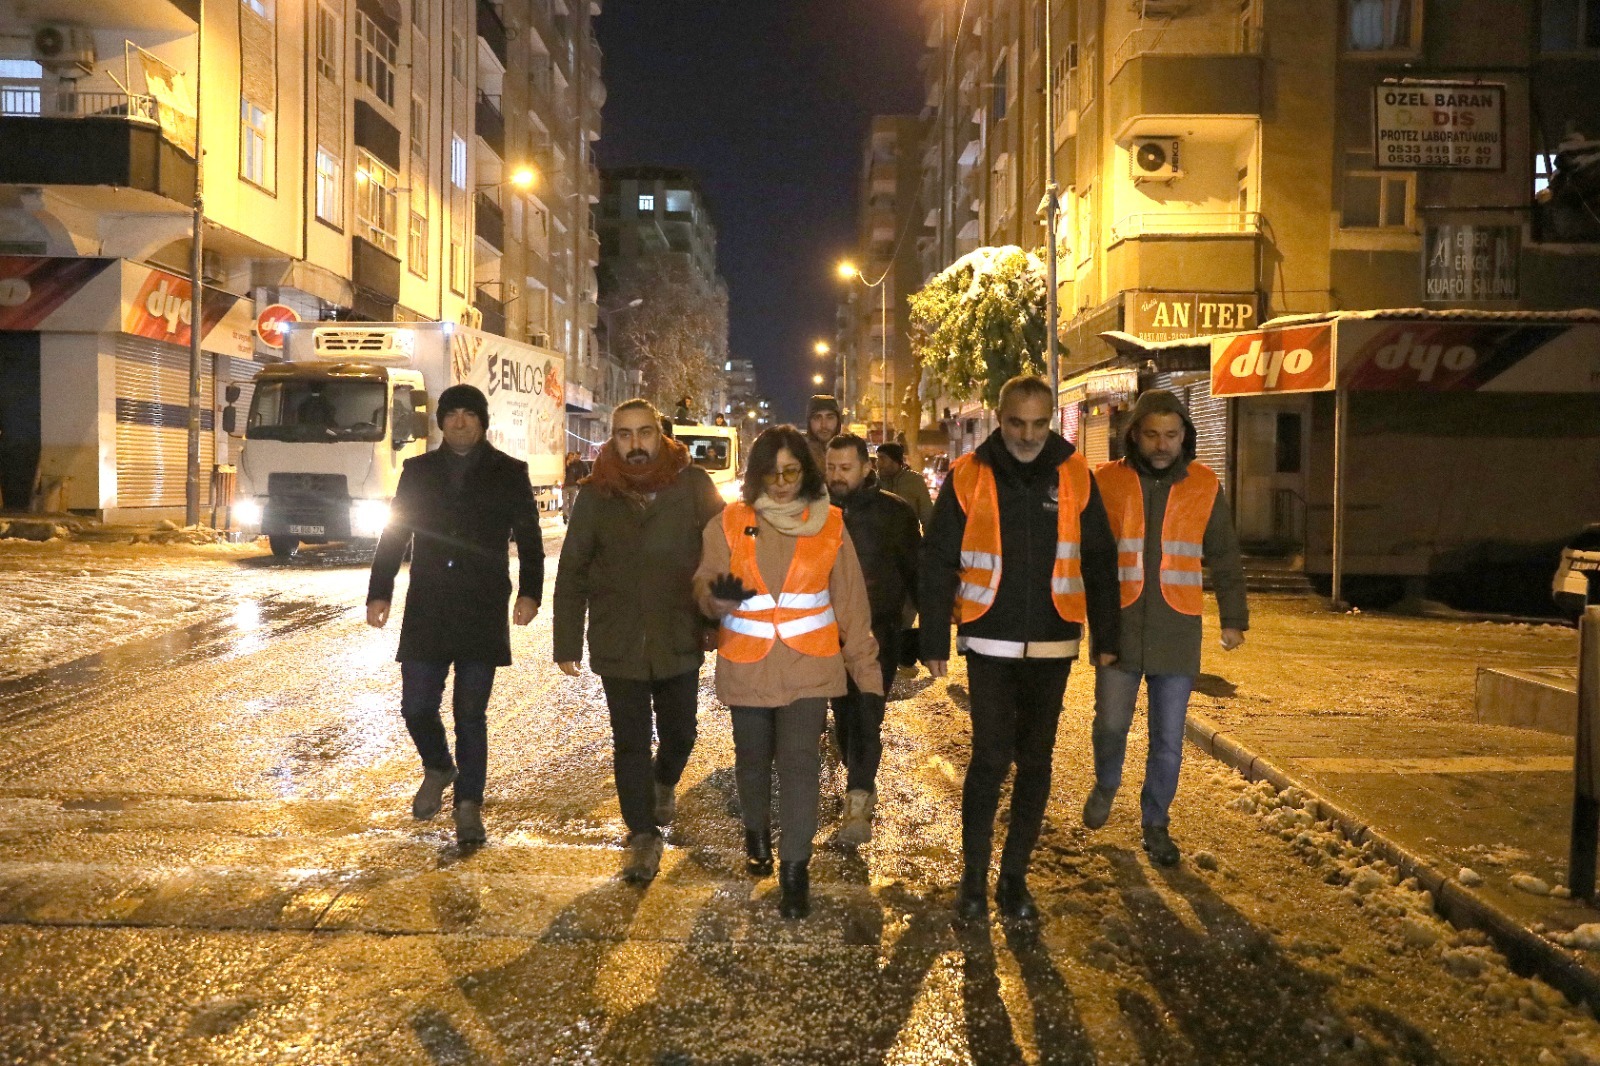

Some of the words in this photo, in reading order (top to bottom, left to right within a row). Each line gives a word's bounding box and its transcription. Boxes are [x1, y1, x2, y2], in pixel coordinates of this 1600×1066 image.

[1385, 89, 1429, 106] ÖZEL
[1434, 93, 1493, 107] BARAN
[1380, 130, 1418, 141] PROTEZ
[1387, 144, 1420, 154] 0533
[1230, 340, 1313, 388] dyo
[1375, 332, 1477, 382] dyo
[501, 358, 543, 396] ENLOG
